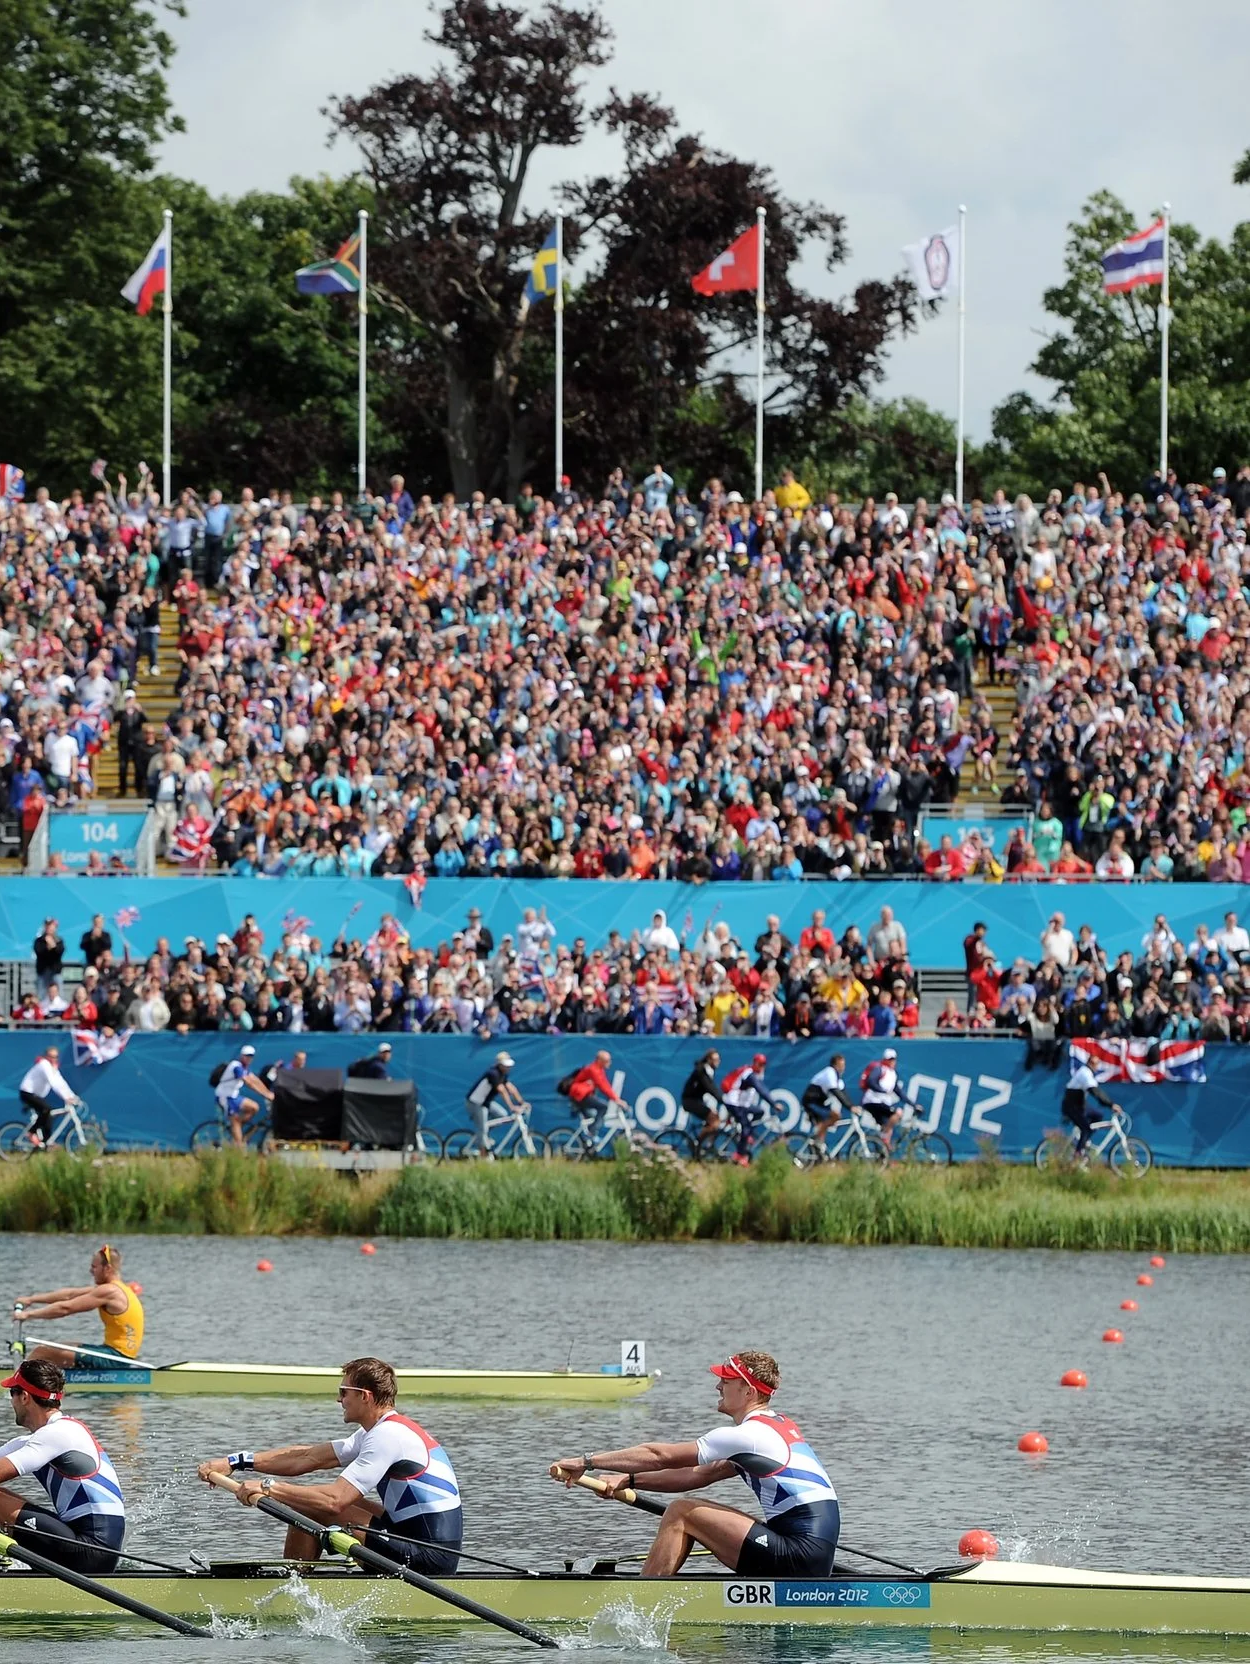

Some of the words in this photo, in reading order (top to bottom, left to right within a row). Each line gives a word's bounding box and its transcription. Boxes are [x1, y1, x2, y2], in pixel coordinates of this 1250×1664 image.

[81, 822, 119, 842] 104
[604, 1070, 842, 1132] Loo
[860, 1073, 1012, 1136] 012
[626, 1344, 640, 1363] 4
[70, 1371, 98, 1381] London
[727, 1585, 772, 1604] GBR
[786, 1588, 835, 1601] London
[838, 1589, 869, 1601] 2012
